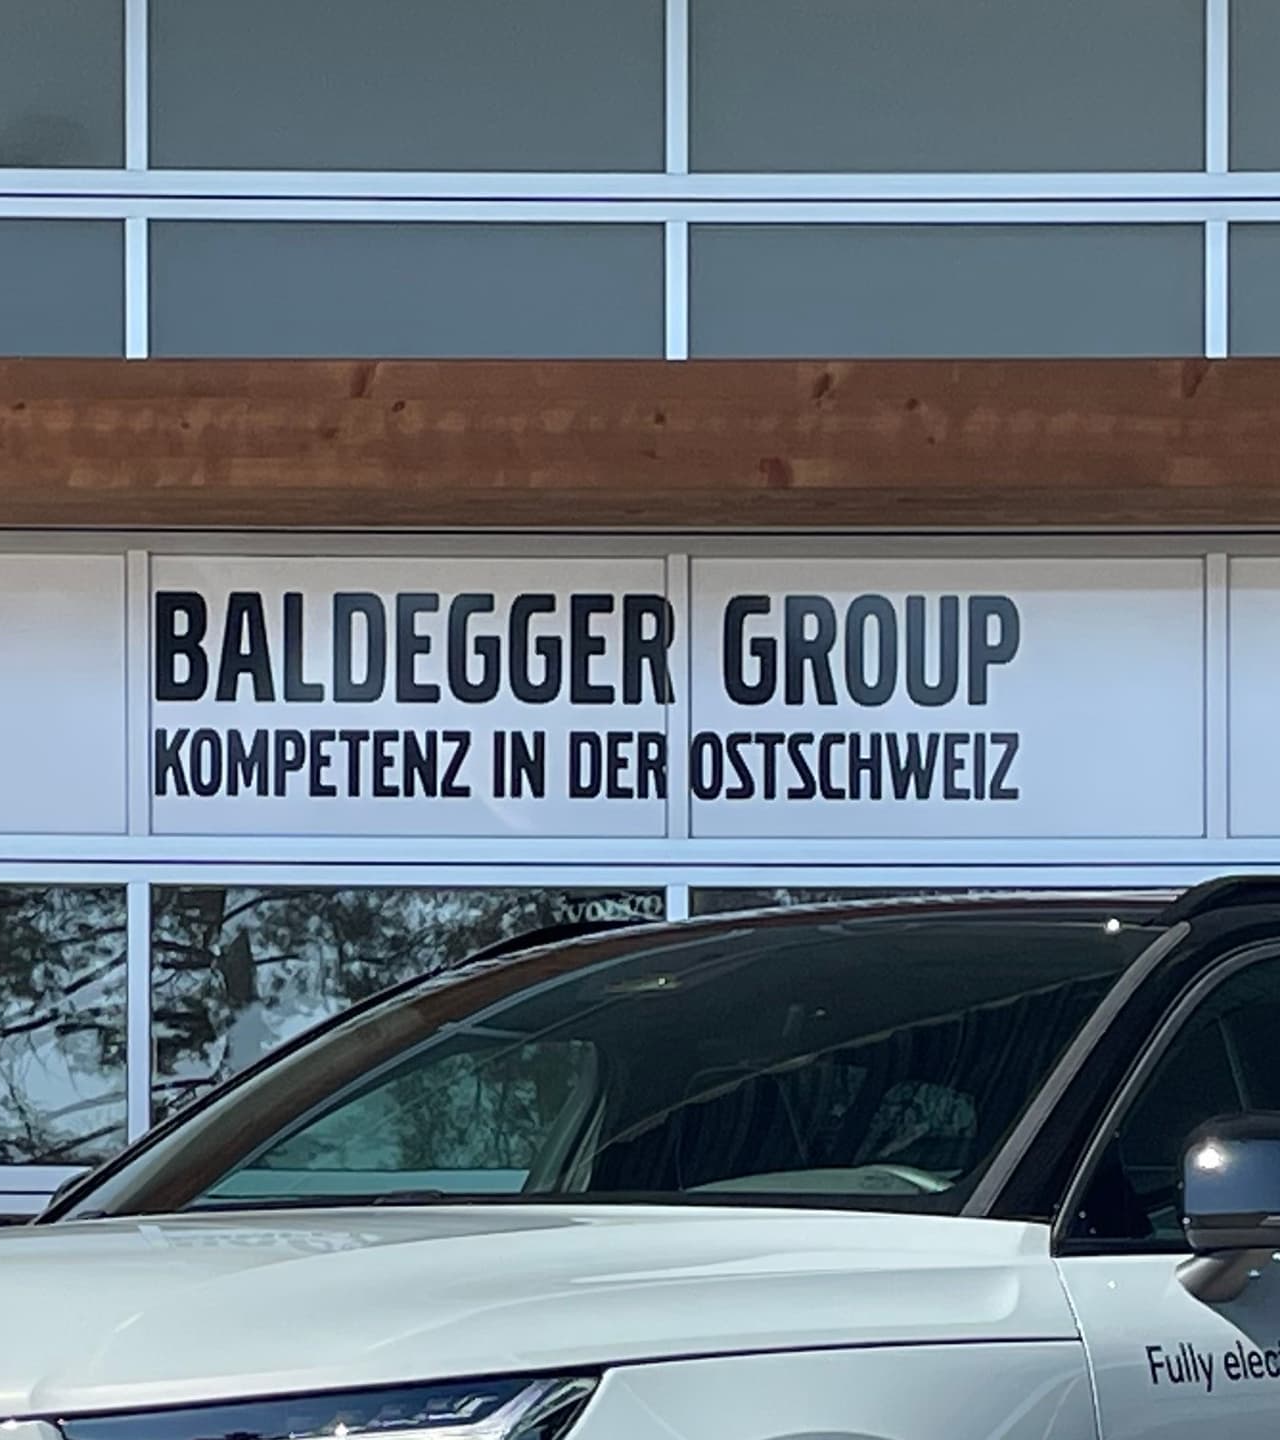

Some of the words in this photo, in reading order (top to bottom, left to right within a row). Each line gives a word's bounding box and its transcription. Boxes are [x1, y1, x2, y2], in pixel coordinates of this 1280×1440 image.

[155, 591, 675, 705] BALDEGGER
[723, 594, 1021, 706] GROUP
[154, 728, 472, 798] KOMPETENZ
[493, 731, 545, 798] IN
[569, 731, 668, 799] DER
[689, 731, 1020, 801] OSTSCHWEIZ
[1145, 1342, 1213, 1392] Fully
